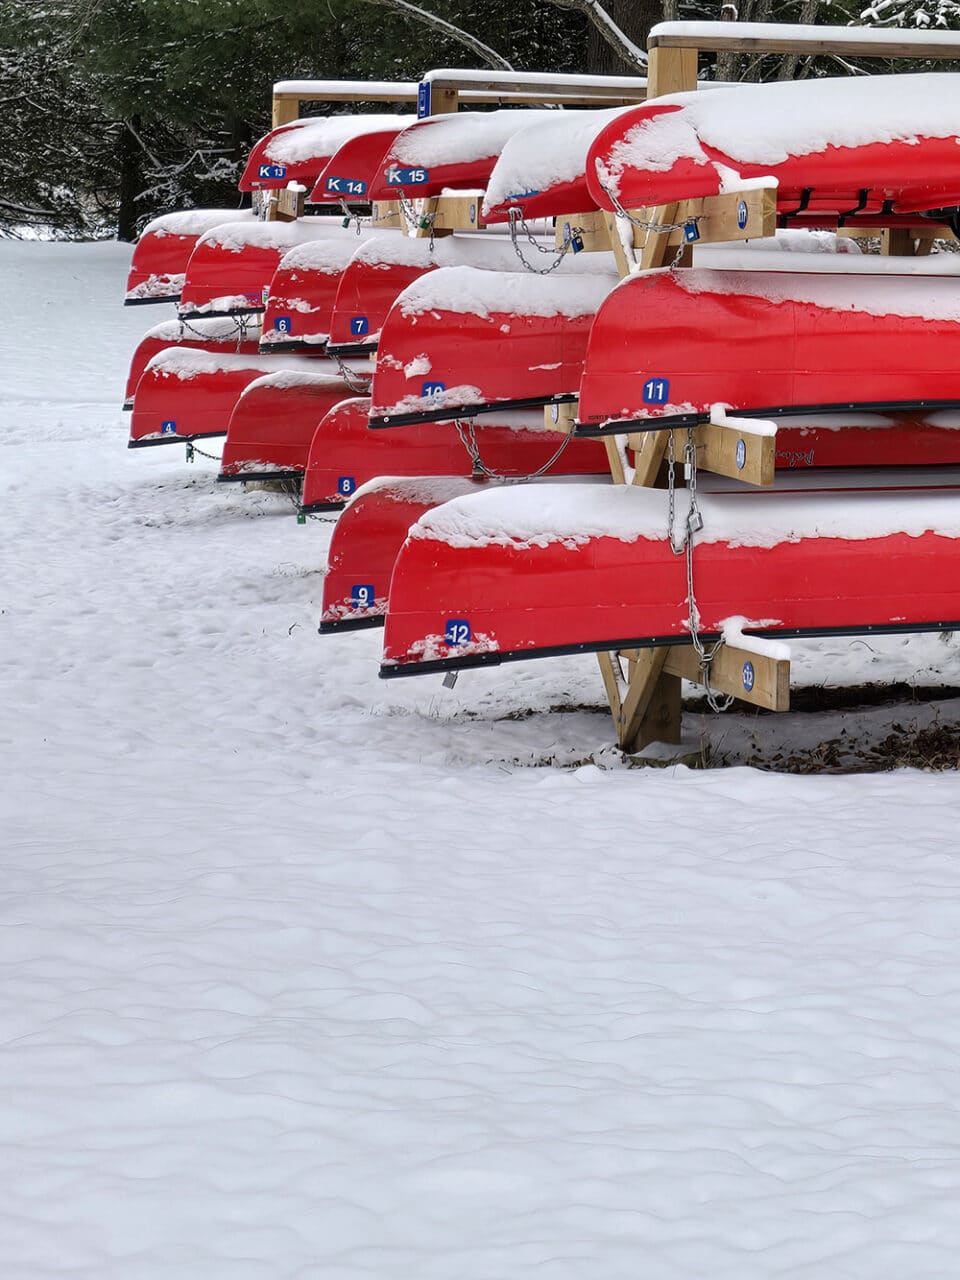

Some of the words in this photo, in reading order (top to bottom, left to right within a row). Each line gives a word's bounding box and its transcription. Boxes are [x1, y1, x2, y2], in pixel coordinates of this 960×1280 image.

[259, 166, 270, 177] K
[388, 170, 401, 182] K
[409, 170, 425, 182] 15
[328, 178, 340, 191] K
[347, 182, 362, 194] 14
[278, 320, 287, 333] 6
[355, 320, 364, 333] 7
[646, 382, 664, 400] 11
[342, 479, 351, 492] 8
[358, 587, 368, 604] 9
[450, 625, 468, 642] 12
